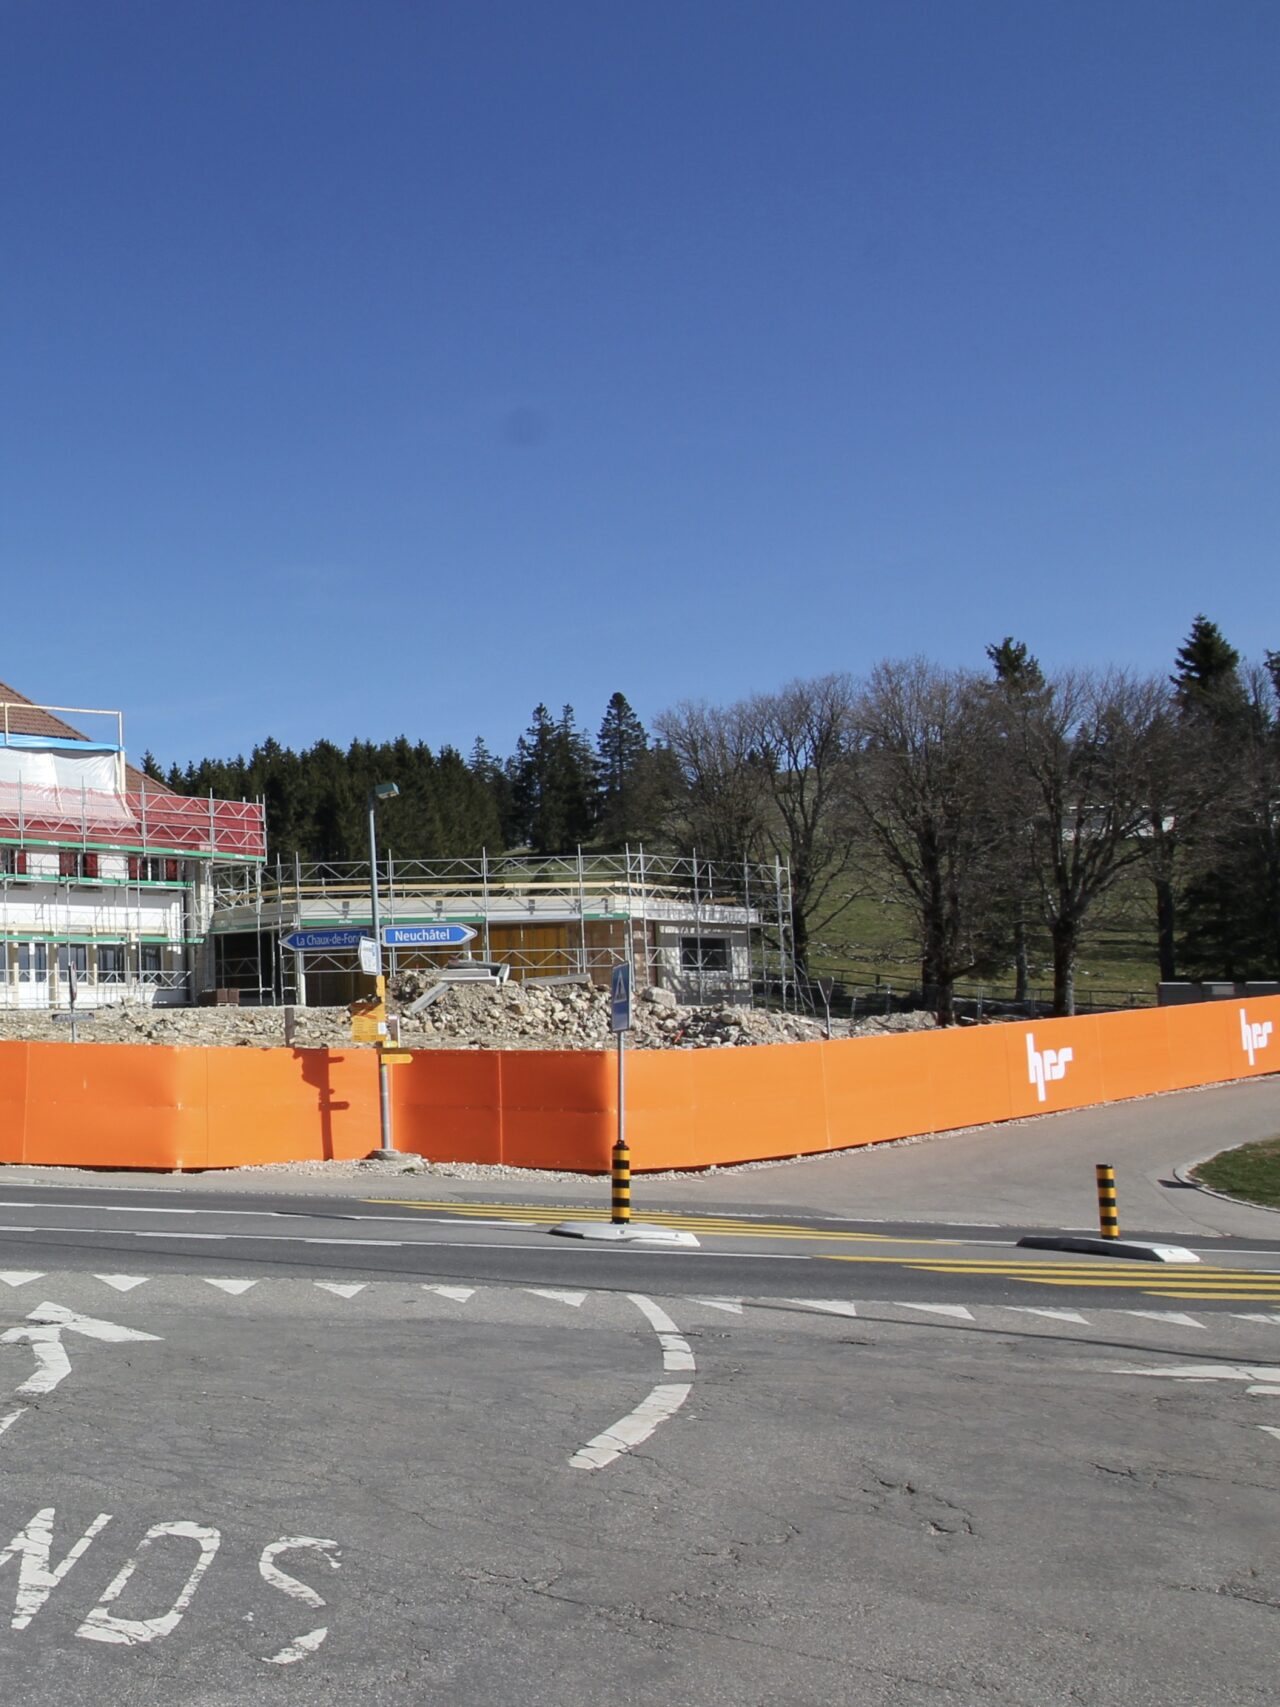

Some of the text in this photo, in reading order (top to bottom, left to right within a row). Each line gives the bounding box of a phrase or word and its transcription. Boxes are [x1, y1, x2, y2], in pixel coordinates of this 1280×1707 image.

[296, 932, 363, 946] La Chaux-de-Fond
[395, 928, 450, 942] Neuchâtel
